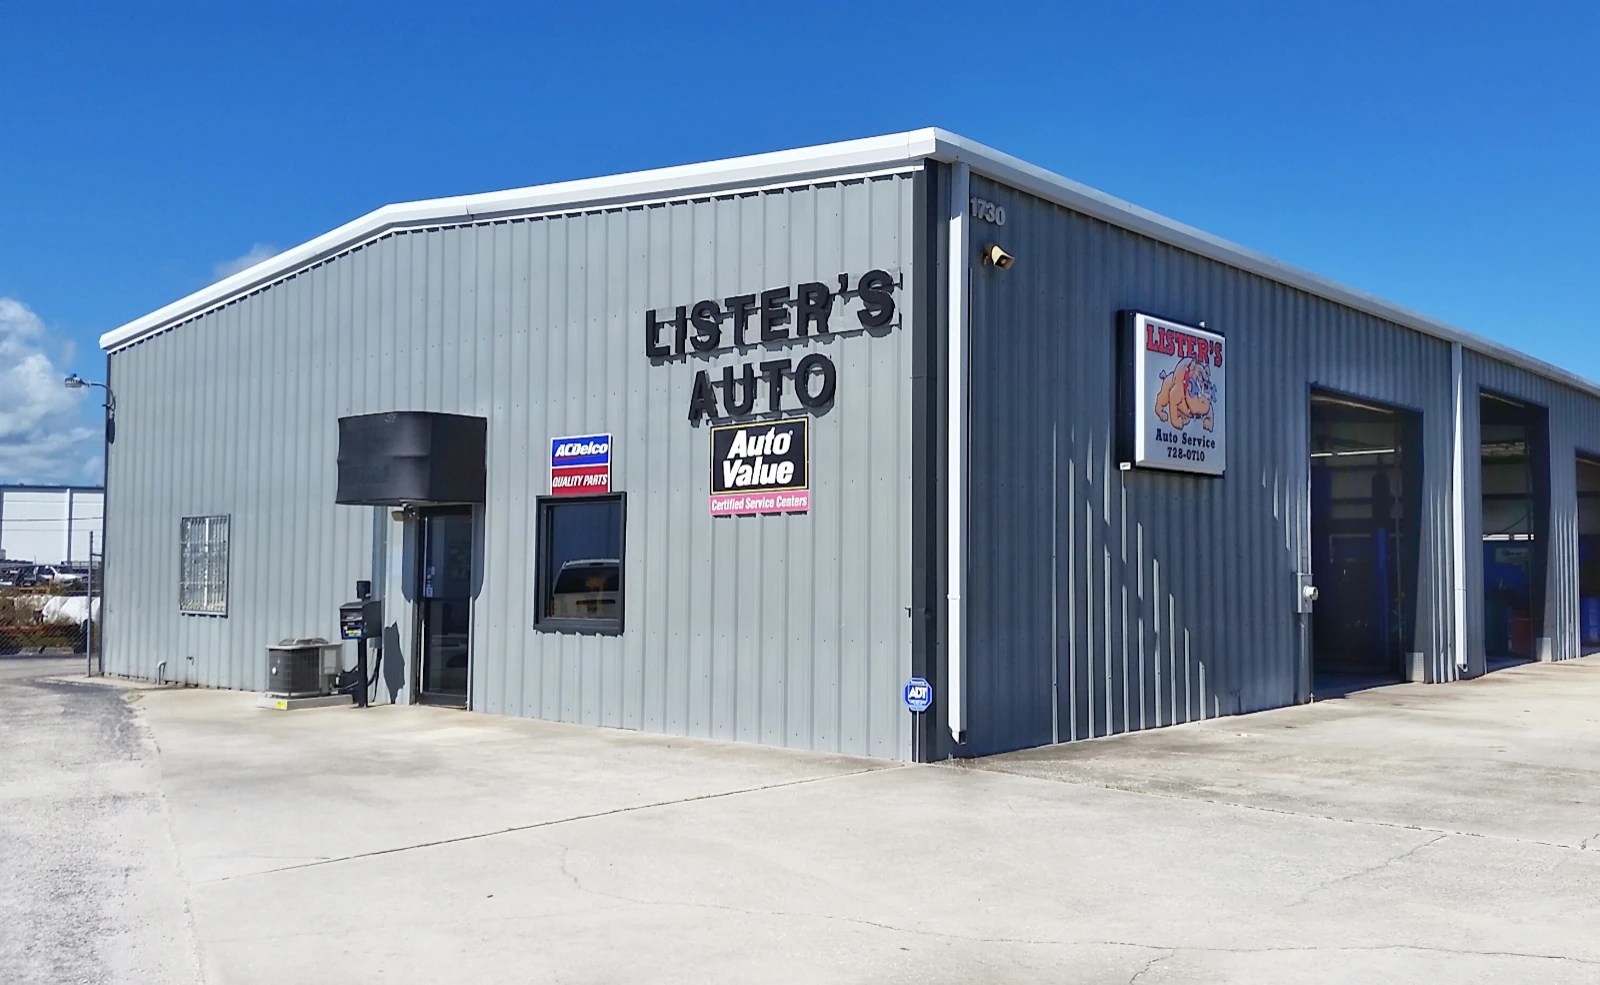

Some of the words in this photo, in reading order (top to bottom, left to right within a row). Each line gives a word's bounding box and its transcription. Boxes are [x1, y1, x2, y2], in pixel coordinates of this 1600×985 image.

[971, 197, 1005, 226] 1730
[646, 269, 896, 358] LISTER'S
[1146, 323, 1223, 368] LISTER'S
[688, 353, 837, 421] AUTO
[554, 440, 609, 457] ACDelco
[726, 426, 792, 459] Auto
[1156, 428, 1178, 444] Auto
[1181, 432, 1216, 449] Service
[1167, 447, 1206, 462] 728-0710
[552, 475, 584, 488] QUALITY
[583, 474, 608, 486] PARTS
[722, 456, 795, 488] Value
[711, 498, 744, 511] Certified
[745, 496, 775, 509] Service
[776, 495, 808, 508] Centers
[909, 686, 928, 699] ADT
